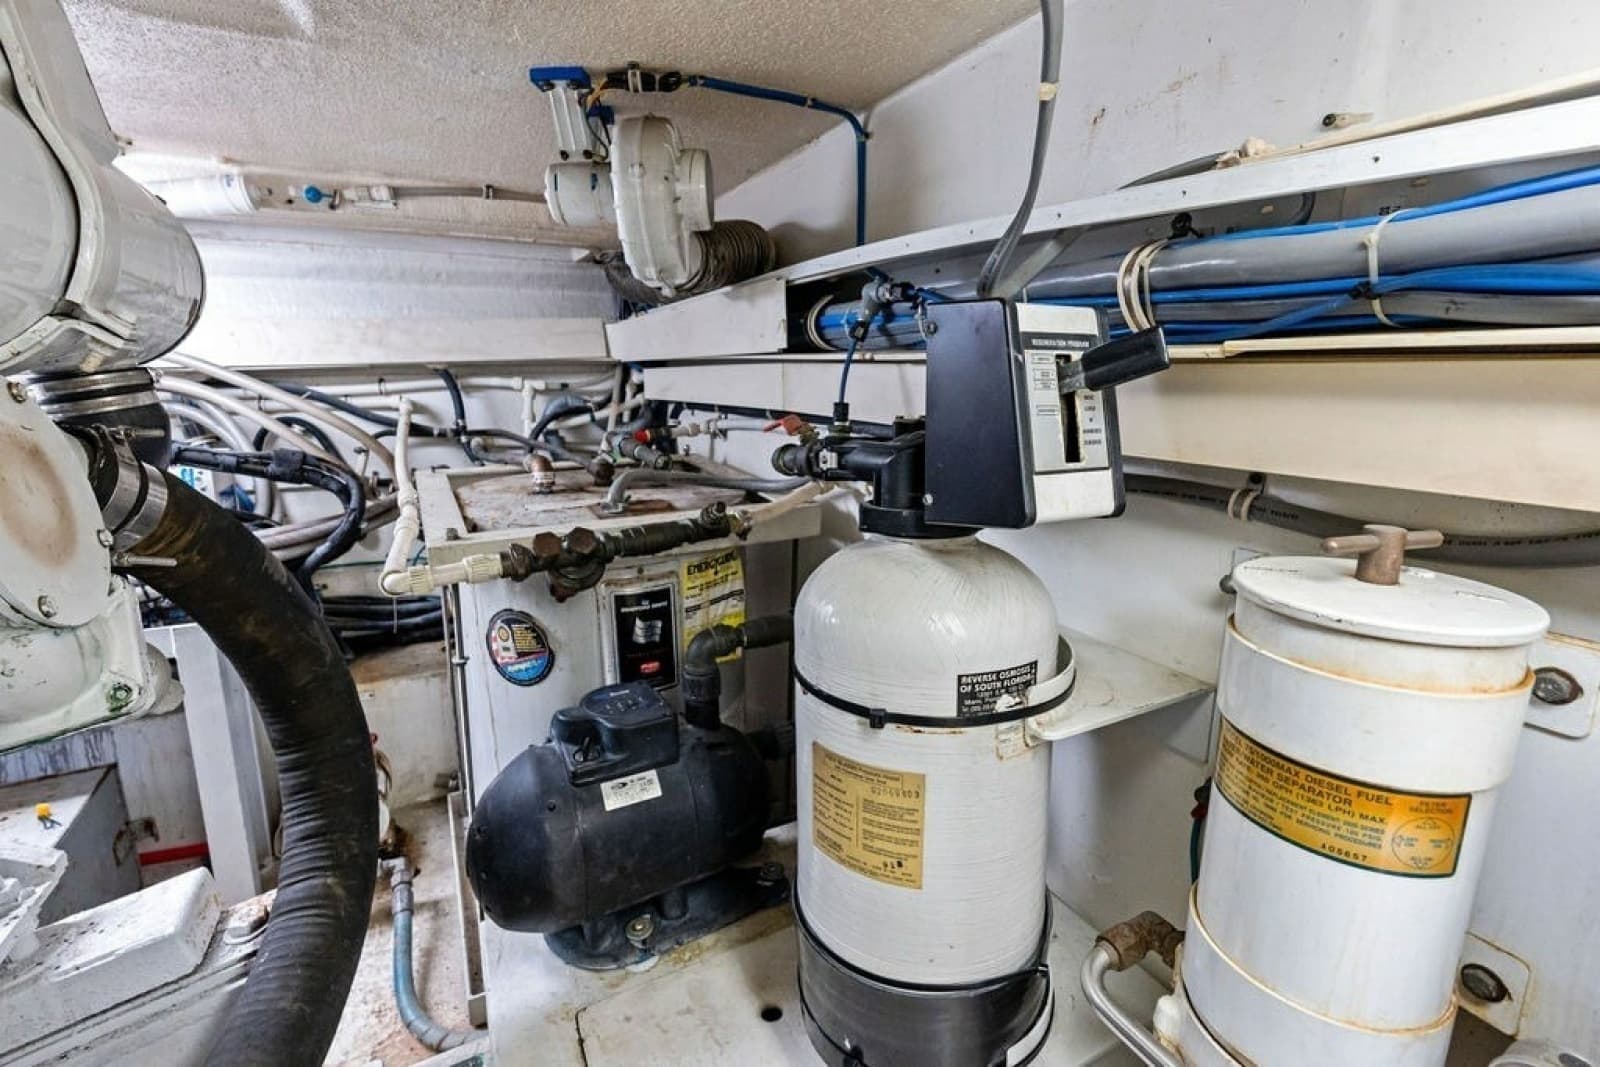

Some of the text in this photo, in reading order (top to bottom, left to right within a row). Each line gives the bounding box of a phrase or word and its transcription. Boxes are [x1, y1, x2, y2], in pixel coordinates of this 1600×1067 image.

[960, 673, 998, 685] REVERSE
[999, 666, 1031, 679] OSMOSIS
[960, 685, 972, 693] OF
[974, 680, 1002, 692] SOUTH
[1003, 672, 1033, 688] FLORIDA
[1276, 772, 1353, 807] SEPARATOR
[1305, 773, 1352, 795] DIESEL
[1357, 790, 1392, 806] FUEL
